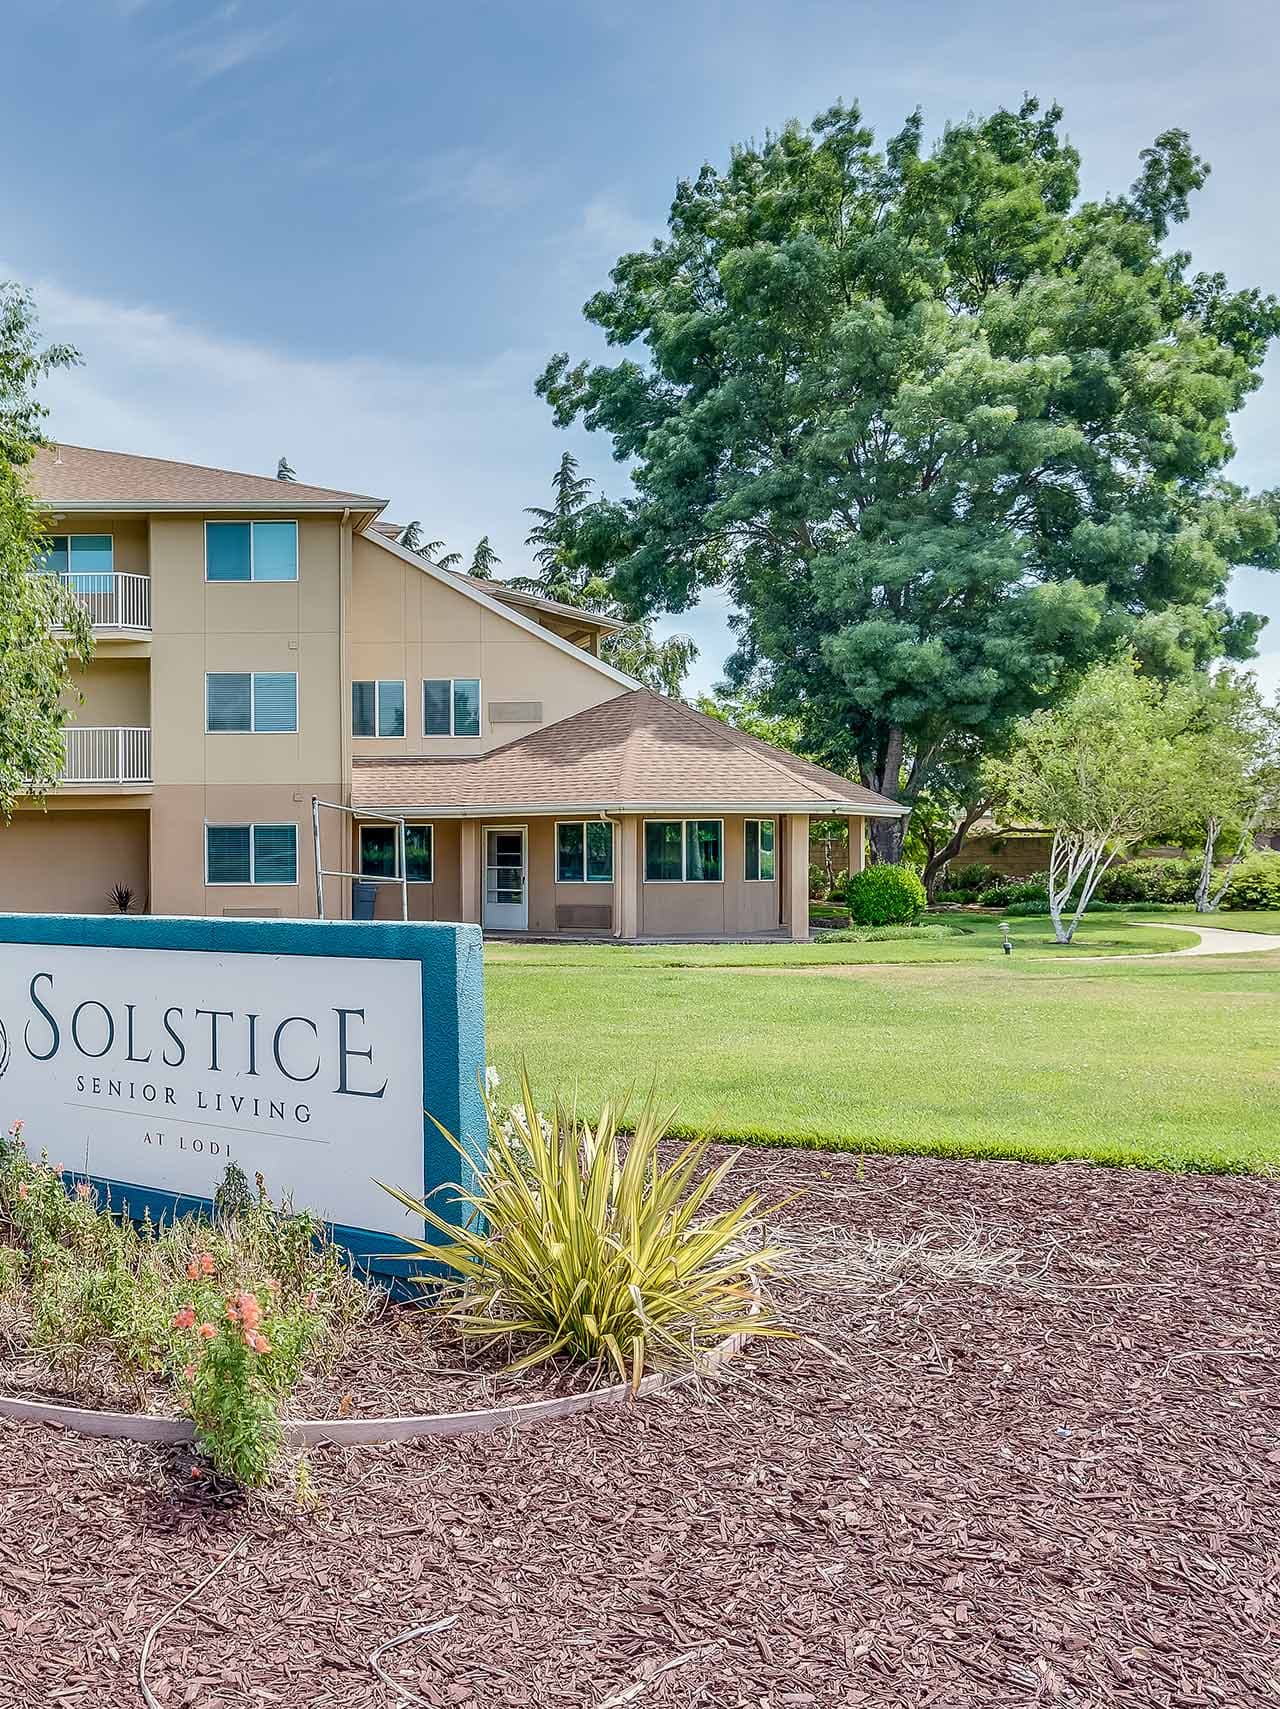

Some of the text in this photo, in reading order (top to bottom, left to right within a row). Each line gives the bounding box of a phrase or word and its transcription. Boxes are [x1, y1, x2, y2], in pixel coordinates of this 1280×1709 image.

[24, 972, 389, 1099] SOLSTICE
[76, 1075, 312, 1123] SENIOR LIVING
[143, 1132, 232, 1158] AT LODI
